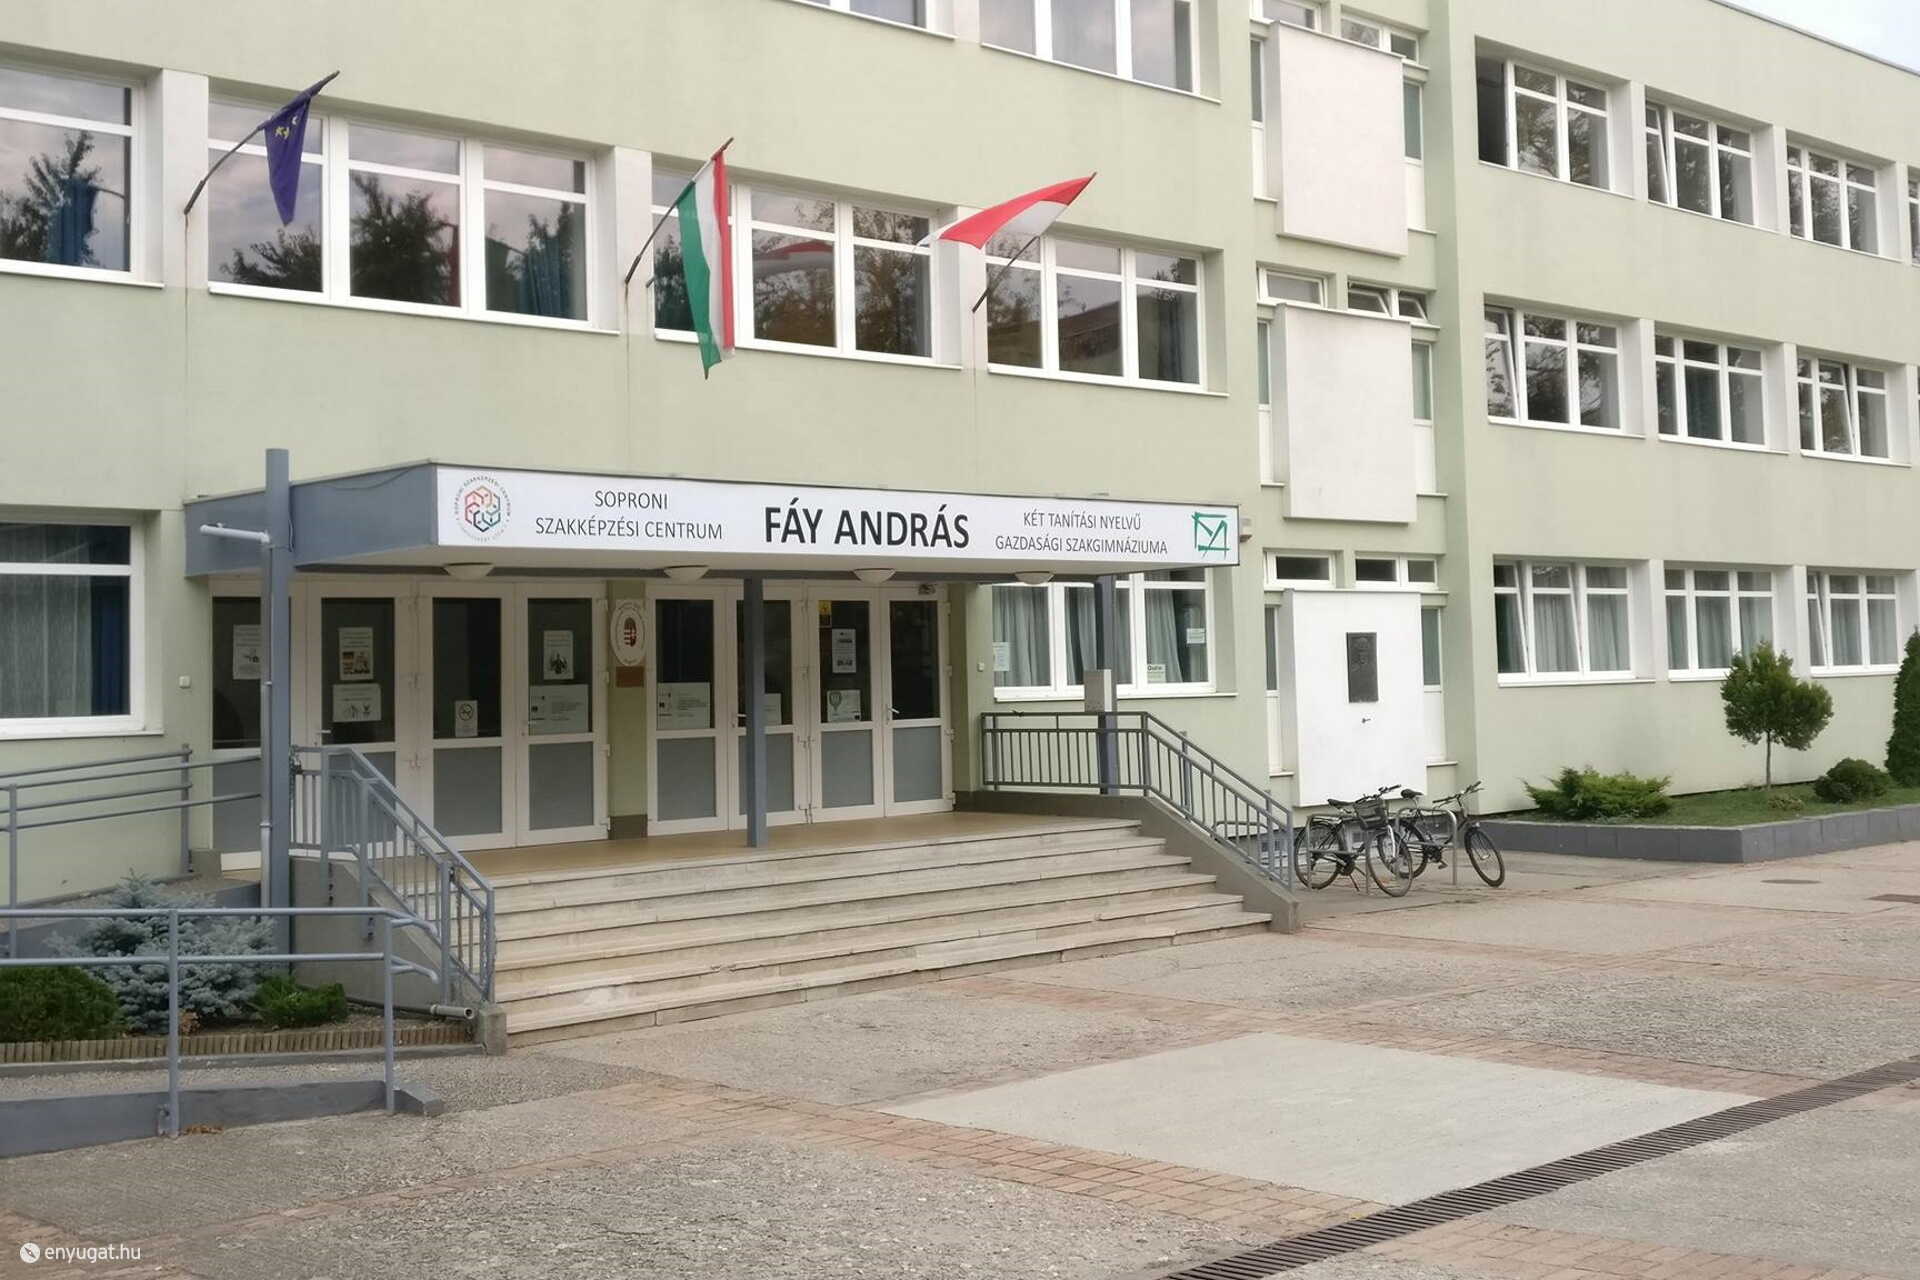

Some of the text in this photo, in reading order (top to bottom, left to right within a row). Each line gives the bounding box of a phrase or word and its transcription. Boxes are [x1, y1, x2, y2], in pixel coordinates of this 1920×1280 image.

[595, 490, 669, 510] SOPRONI
[535, 514, 723, 540] SZAKKÉPZÉSI CENTRUM
[765, 497, 970, 549] FÁY ANDRÁS
[1023, 509, 1142, 530] KÉT TANÍTÁSI NYELVŰ
[995, 533, 1168, 555] GAZDASÁGI SZAKGIMNÁZIUMA
